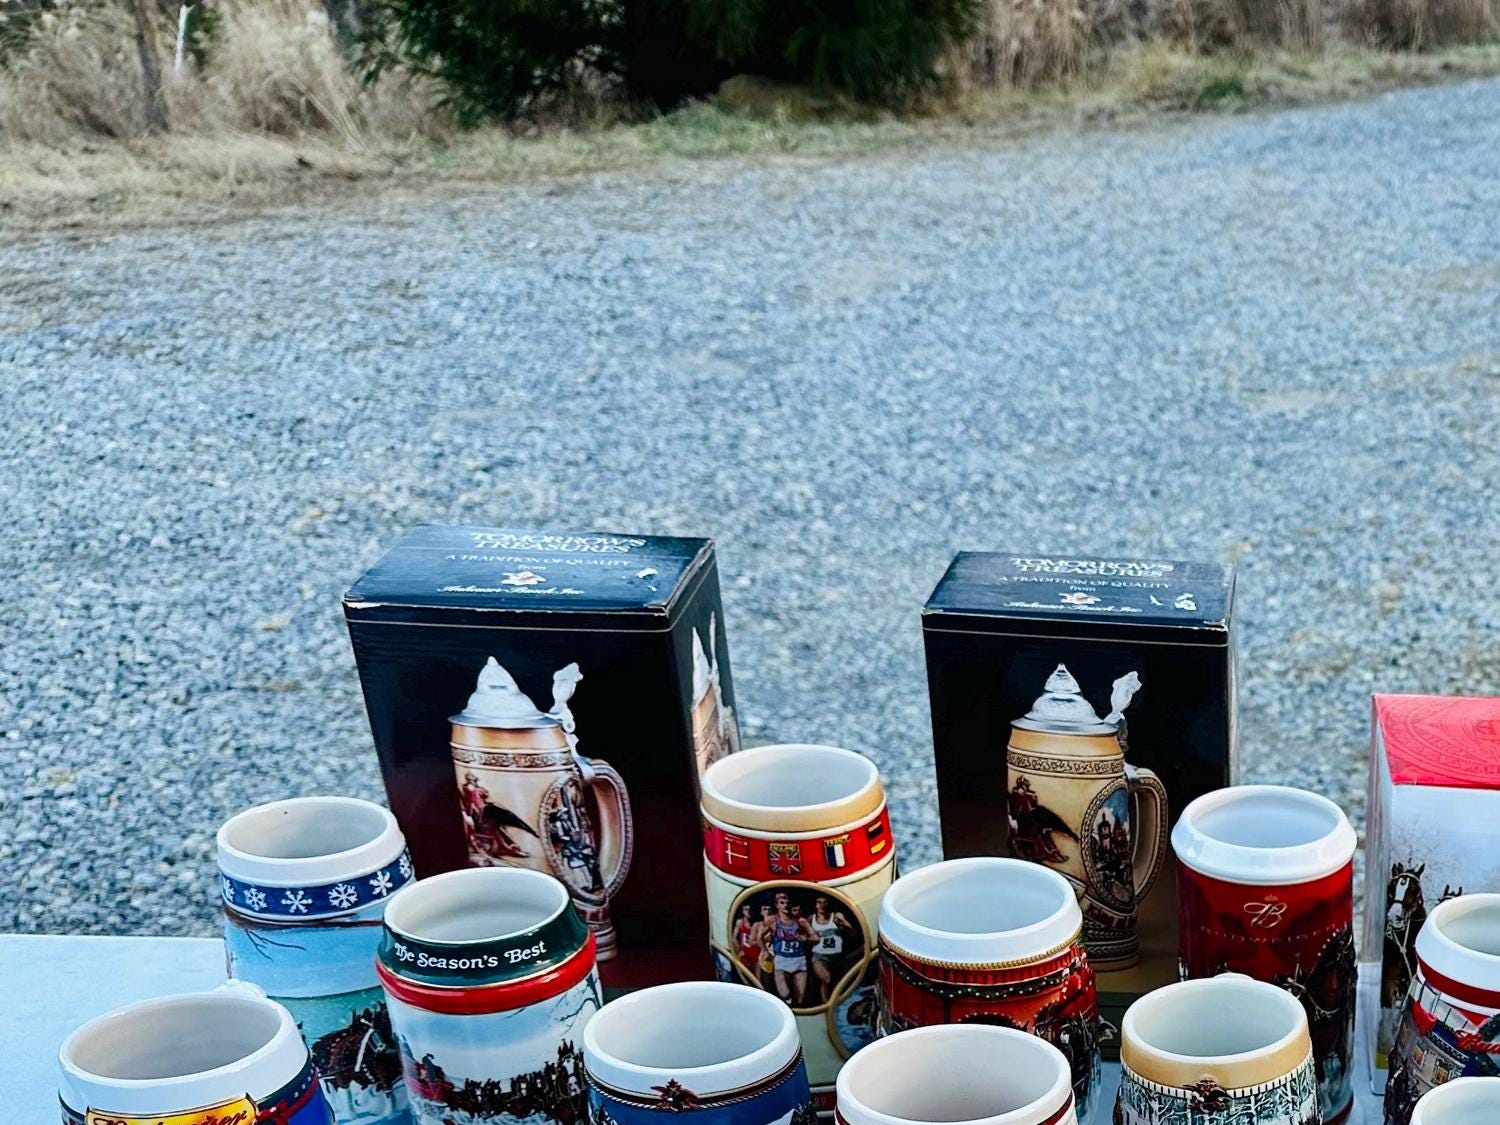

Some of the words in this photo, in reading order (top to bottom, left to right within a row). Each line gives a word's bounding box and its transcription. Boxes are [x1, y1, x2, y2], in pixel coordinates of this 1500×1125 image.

[473, 541, 631, 554] TREASURES
[460, 554, 540, 563] TRADITION
[566, 558, 632, 566] QUALITY
[1017, 565, 1163, 577] TREASURES
[1012, 576, 1087, 584] TRADITION
[394, 943, 416, 962] The
[416, 952, 499, 969] Season's
[504, 940, 547, 964] Best
